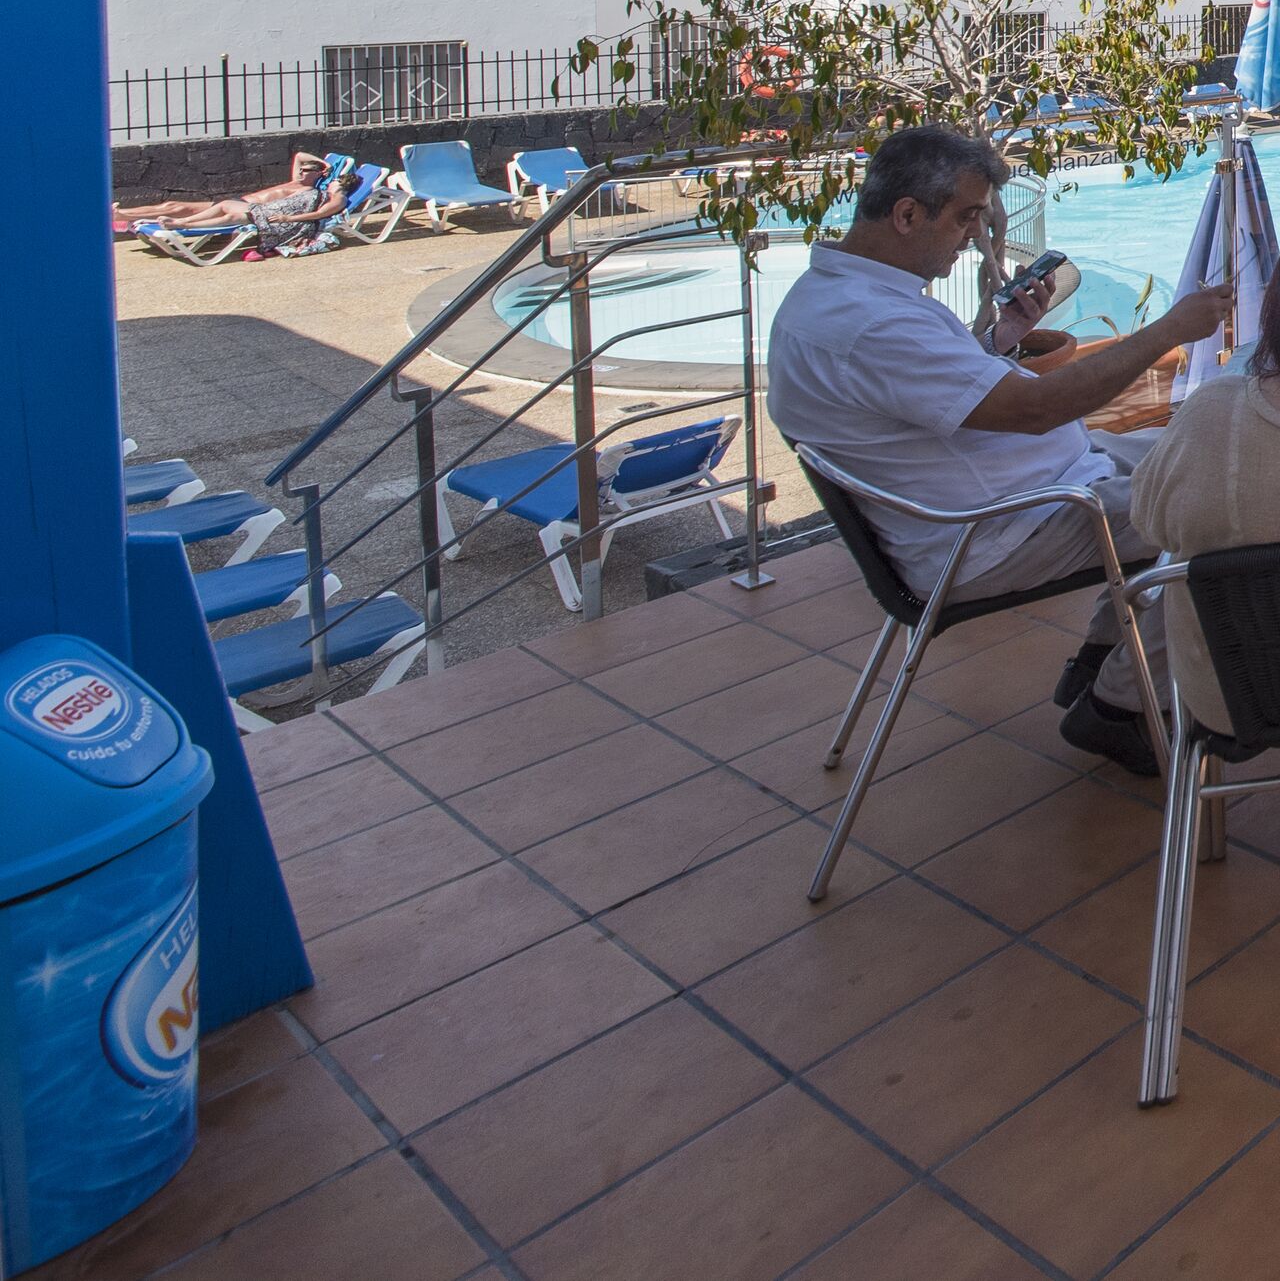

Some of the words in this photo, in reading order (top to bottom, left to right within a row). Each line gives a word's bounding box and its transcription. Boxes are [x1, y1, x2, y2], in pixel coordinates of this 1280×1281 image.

[19, 667, 74, 705] HELADOS
[67, 745, 118, 761] cuida
[114, 737, 133, 752] tu
[129, 695, 154, 742] entorno
